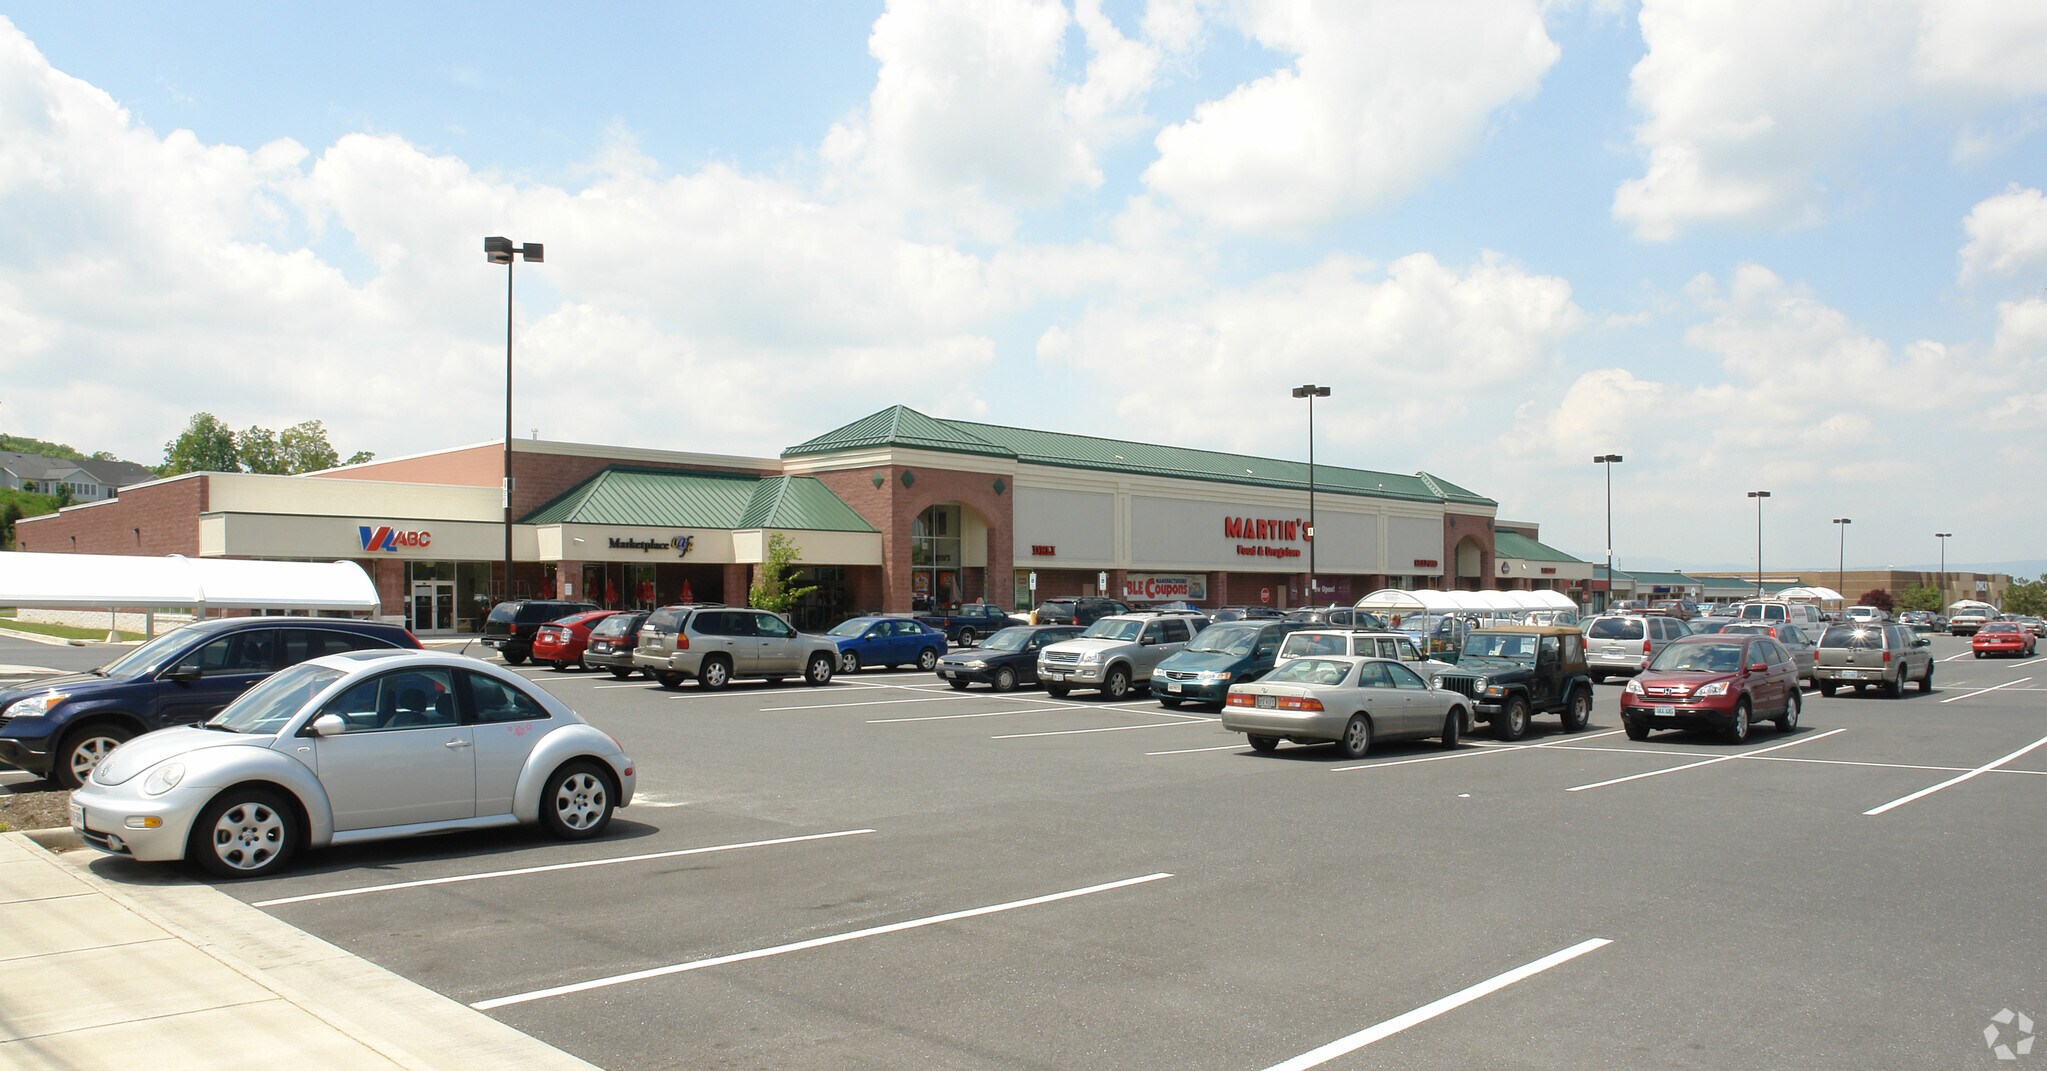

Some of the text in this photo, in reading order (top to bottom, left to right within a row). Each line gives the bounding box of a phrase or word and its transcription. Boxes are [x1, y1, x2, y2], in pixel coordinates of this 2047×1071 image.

[1225, 516, 1311, 541] MARTIN'S
[391, 531, 432, 548] ABC
[608, 537, 670, 553] Marketplace
[1031, 545, 1057, 556] DELI
[1237, 545, 1301, 559] Food & Drugstore
[1145, 578, 1187, 598] Coupons
